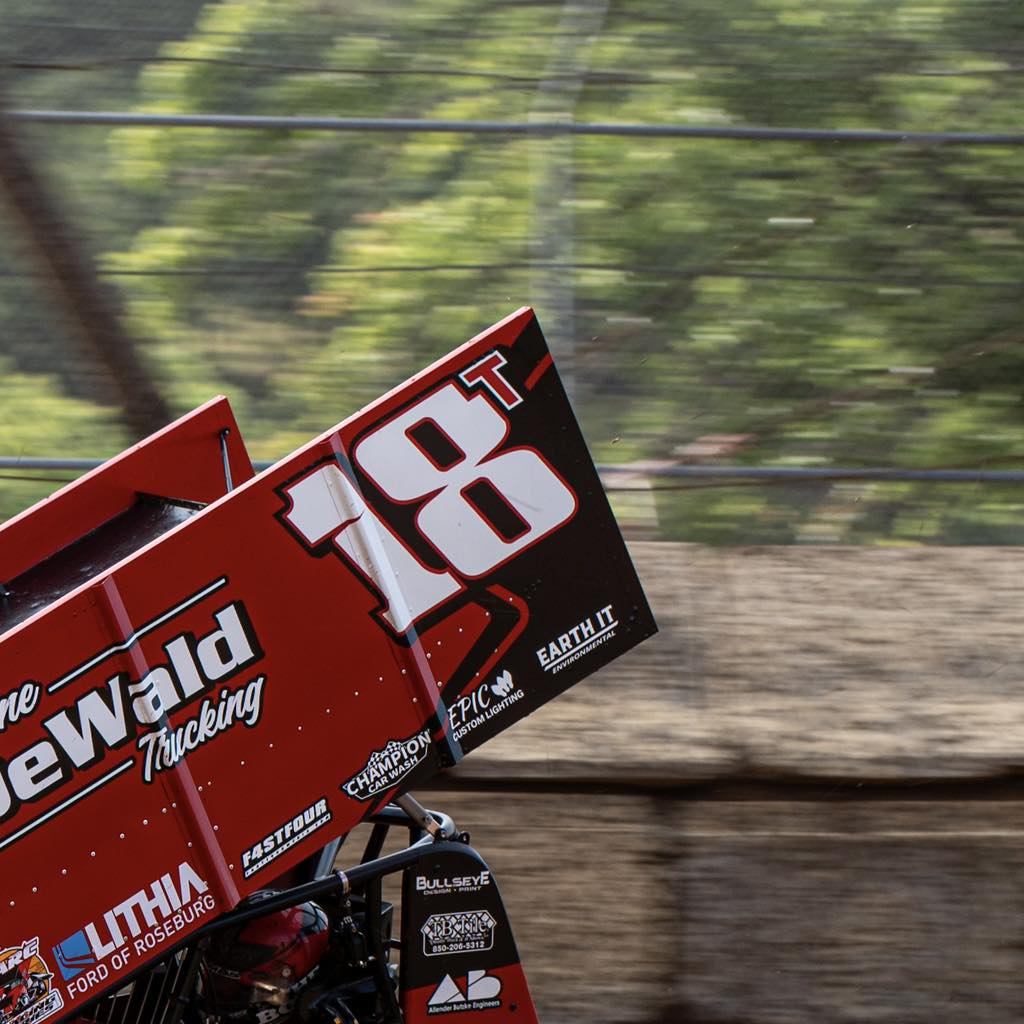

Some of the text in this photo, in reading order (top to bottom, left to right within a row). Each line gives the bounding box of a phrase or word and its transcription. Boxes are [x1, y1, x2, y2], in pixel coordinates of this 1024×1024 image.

[285, 382, 577, 633] 18
[458, 349, 524, 411] T
[536, 604, 614, 667] EARTH IT
[552, 630, 616, 674] ENVIRONMENTAL
[139, 678, 264, 781] Trucking
[447, 683, 491, 729] EPIC
[451, 689, 525, 742] CUSTOM LIGHTING
[346, 731, 431, 796] CHAMPION
[368, 756, 418, 793] CAR WASH
[242, 799, 328, 867] F4STFOUR
[84, 862, 208, 961] LITHIA
[416, 871, 490, 890] BULLSEYE
[67, 895, 216, 999] FORD OF ROSEBURG
